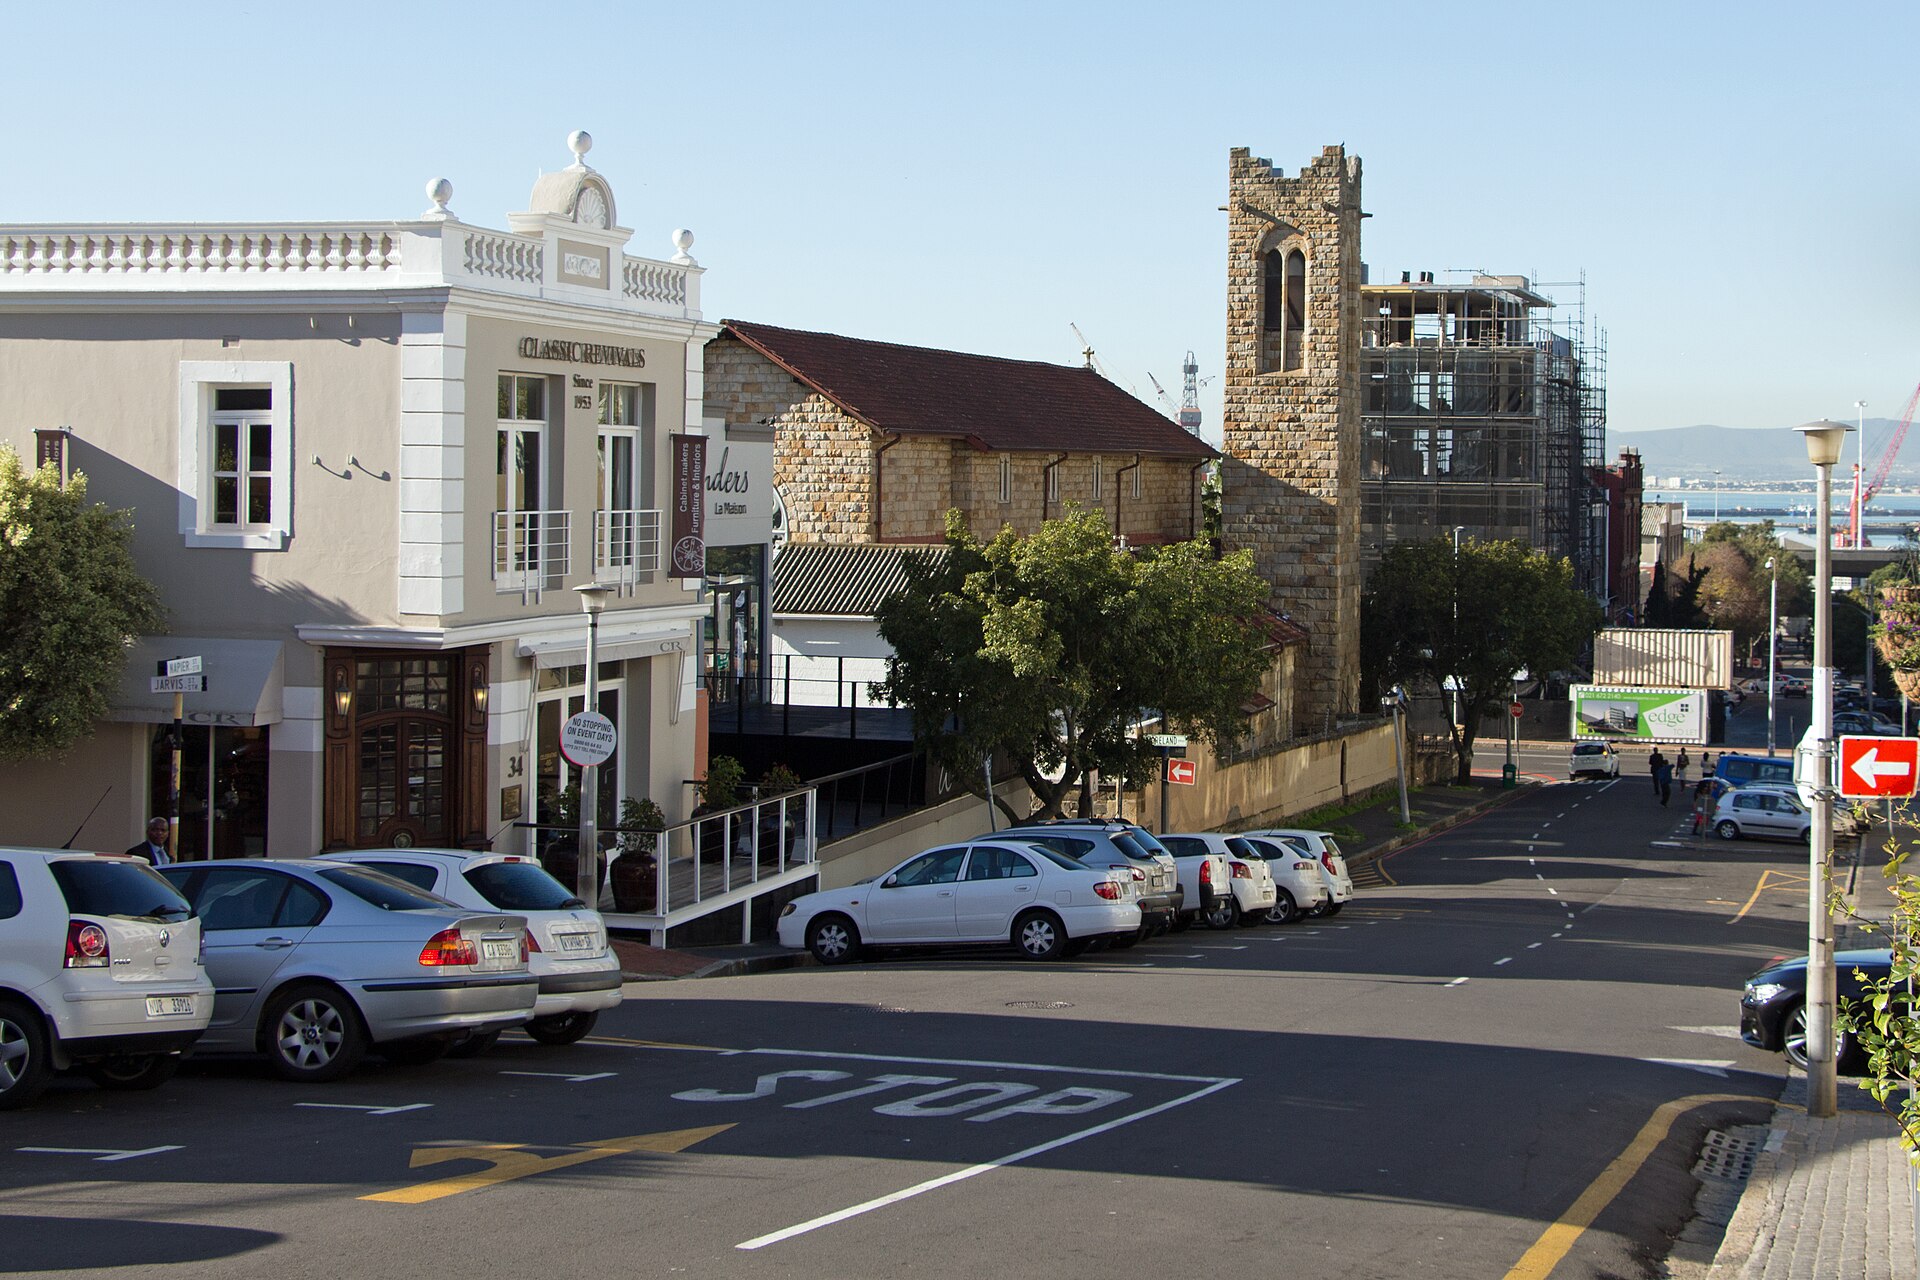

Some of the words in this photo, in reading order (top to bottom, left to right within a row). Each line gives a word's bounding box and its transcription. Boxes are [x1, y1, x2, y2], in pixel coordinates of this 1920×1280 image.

[520, 336, 580, 363] CLASSIC
[582, 342, 646, 368] REVIVALS
[572, 374, 593, 389] Since
[692, 443, 701, 481] Interiors
[704, 446, 749, 494] nders
[679, 477, 688, 512] Cabinet
[692, 482, 700, 490] &
[691, 492, 700, 534] Furniture
[714, 502, 724, 515] La
[724, 502, 747, 515] Maison
[659, 641, 683, 652] CR
[170, 660, 189, 673] NAPIER
[155, 679, 183, 690] JARVIS
[188, 712, 240, 725] CR
[572, 717, 581, 727] NO
[582, 719, 612, 732] STOPPING
[1648, 708, 1686, 728] edge
[567, 726, 577, 735] ON
[577, 728, 597, 739] EVENT
[597, 732, 613, 743] DAYS
[507, 755, 524, 778] 34
[671, 1069, 1133, 1122] STOP
